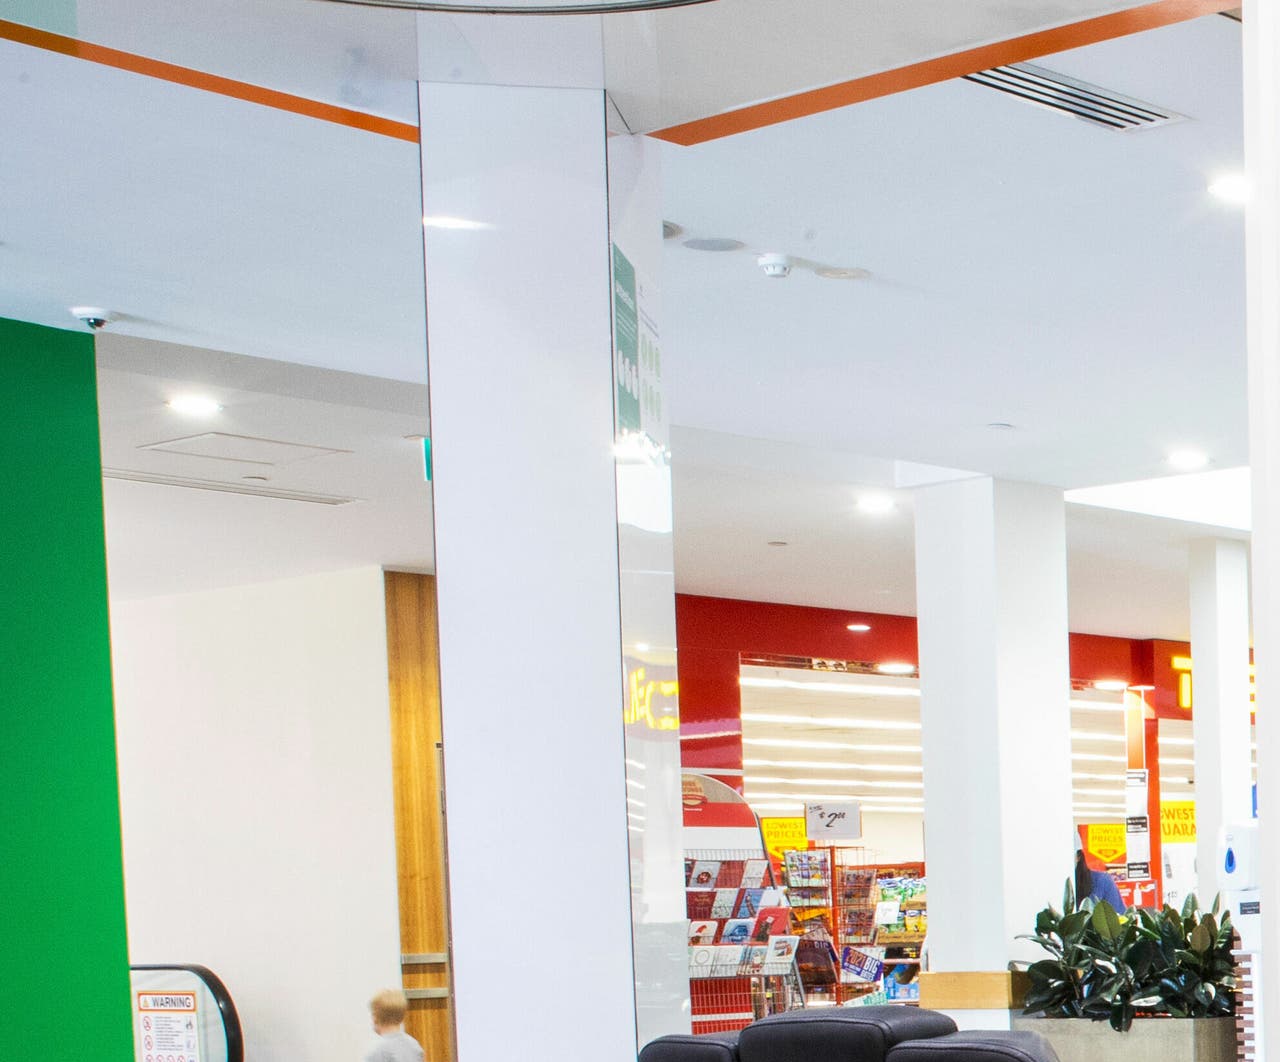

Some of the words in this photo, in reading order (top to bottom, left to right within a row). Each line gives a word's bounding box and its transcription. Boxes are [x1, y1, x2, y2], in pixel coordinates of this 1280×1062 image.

[766, 830, 804, 839] PRICES
[863, 957, 881, 974] BIG
[152, 996, 191, 1008] WARNING
